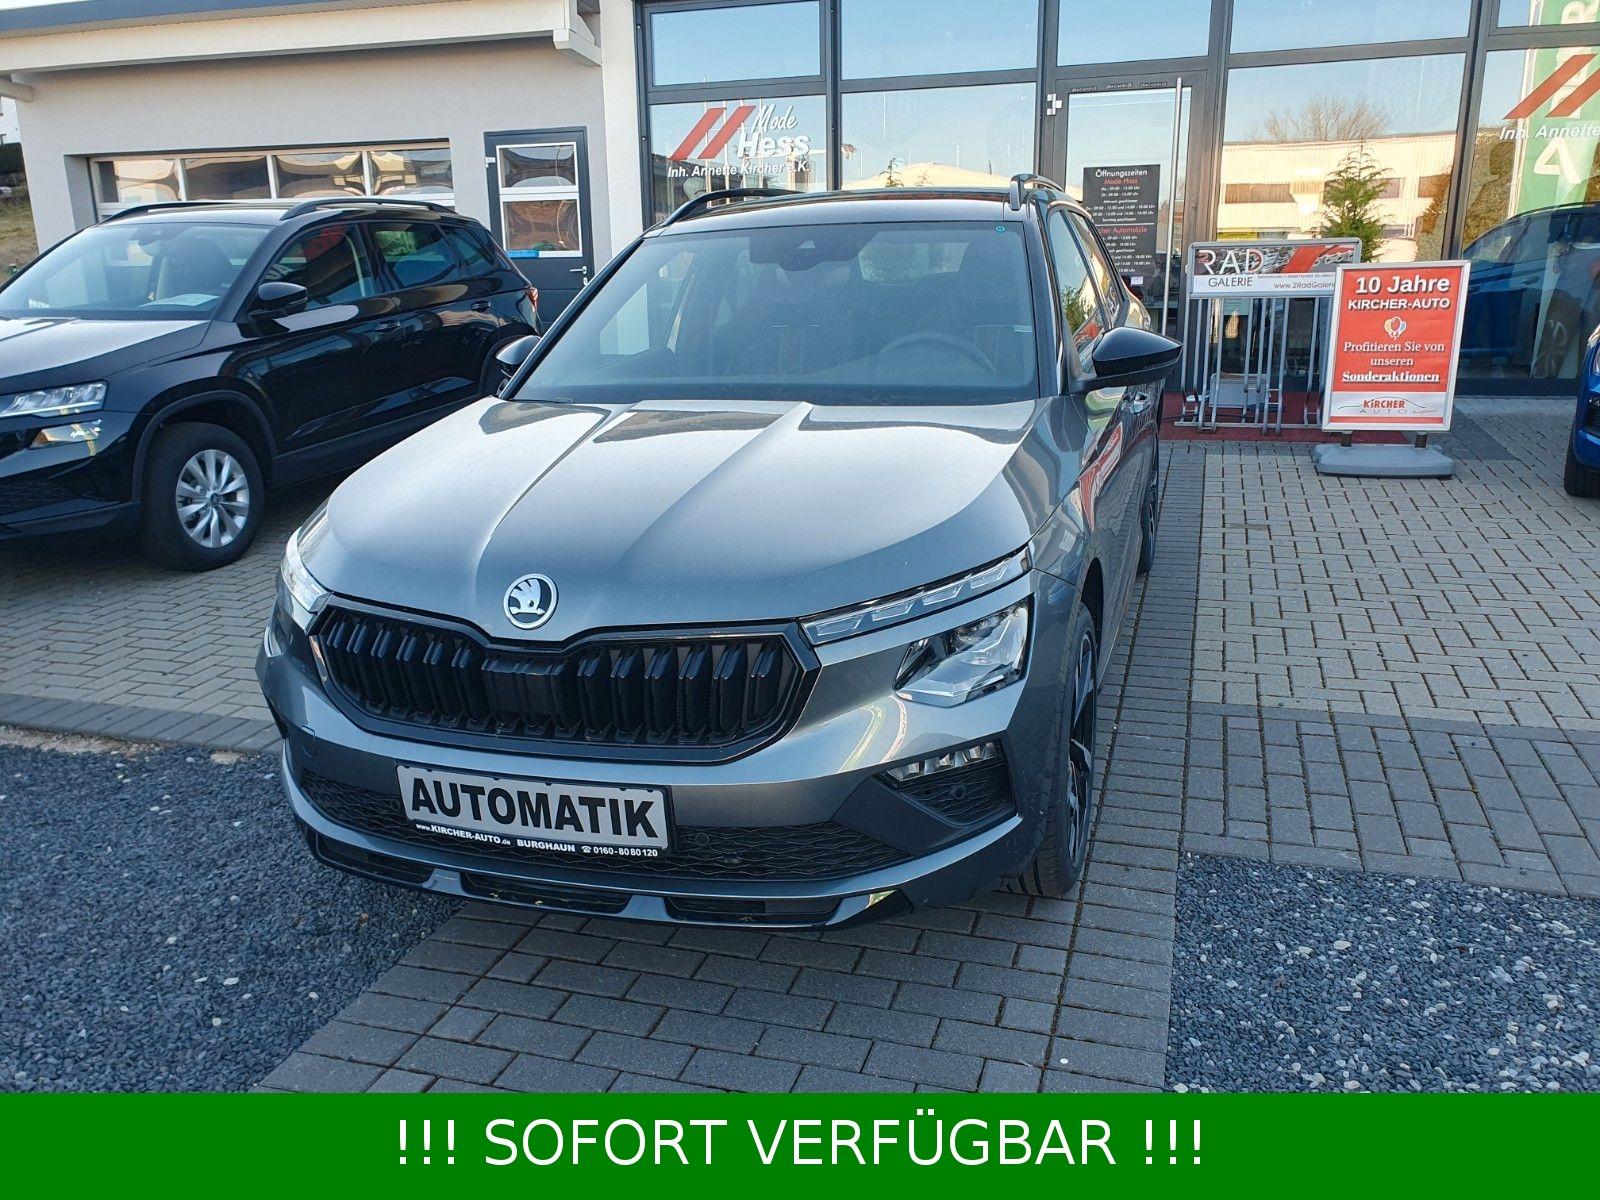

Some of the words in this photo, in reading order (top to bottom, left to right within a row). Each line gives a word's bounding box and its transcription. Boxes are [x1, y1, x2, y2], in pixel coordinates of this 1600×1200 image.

[752, 104, 798, 133] Mode
[737, 133, 810, 158] Hess
[668, 166, 688, 178] Inh.
[692, 164, 738, 177] Annette
[741, 162, 784, 175] Kircher
[1095, 168, 1148, 178] Öffnungszeiten
[1113, 226, 1148, 234] Automobile
[1209, 277, 1254, 288] GALERIE
[1355, 277, 1381, 294] 10
[1387, 275, 1450, 293] Jahre
[1348, 298, 1450, 310] KIRCHER-AUTO
[1344, 341, 1402, 352] Profitieren
[1405, 342, 1421, 352] Sie
[1424, 343, 1445, 352] von
[1371, 358, 1413, 366] unseren
[1341, 370, 1440, 383] Sonderaktionen
[411, 777, 659, 839] AUTOMATIK
[415, 823, 511, 846] www.KIRCHER-AUTO.de
[516, 838, 576, 852] BURGHAUN
